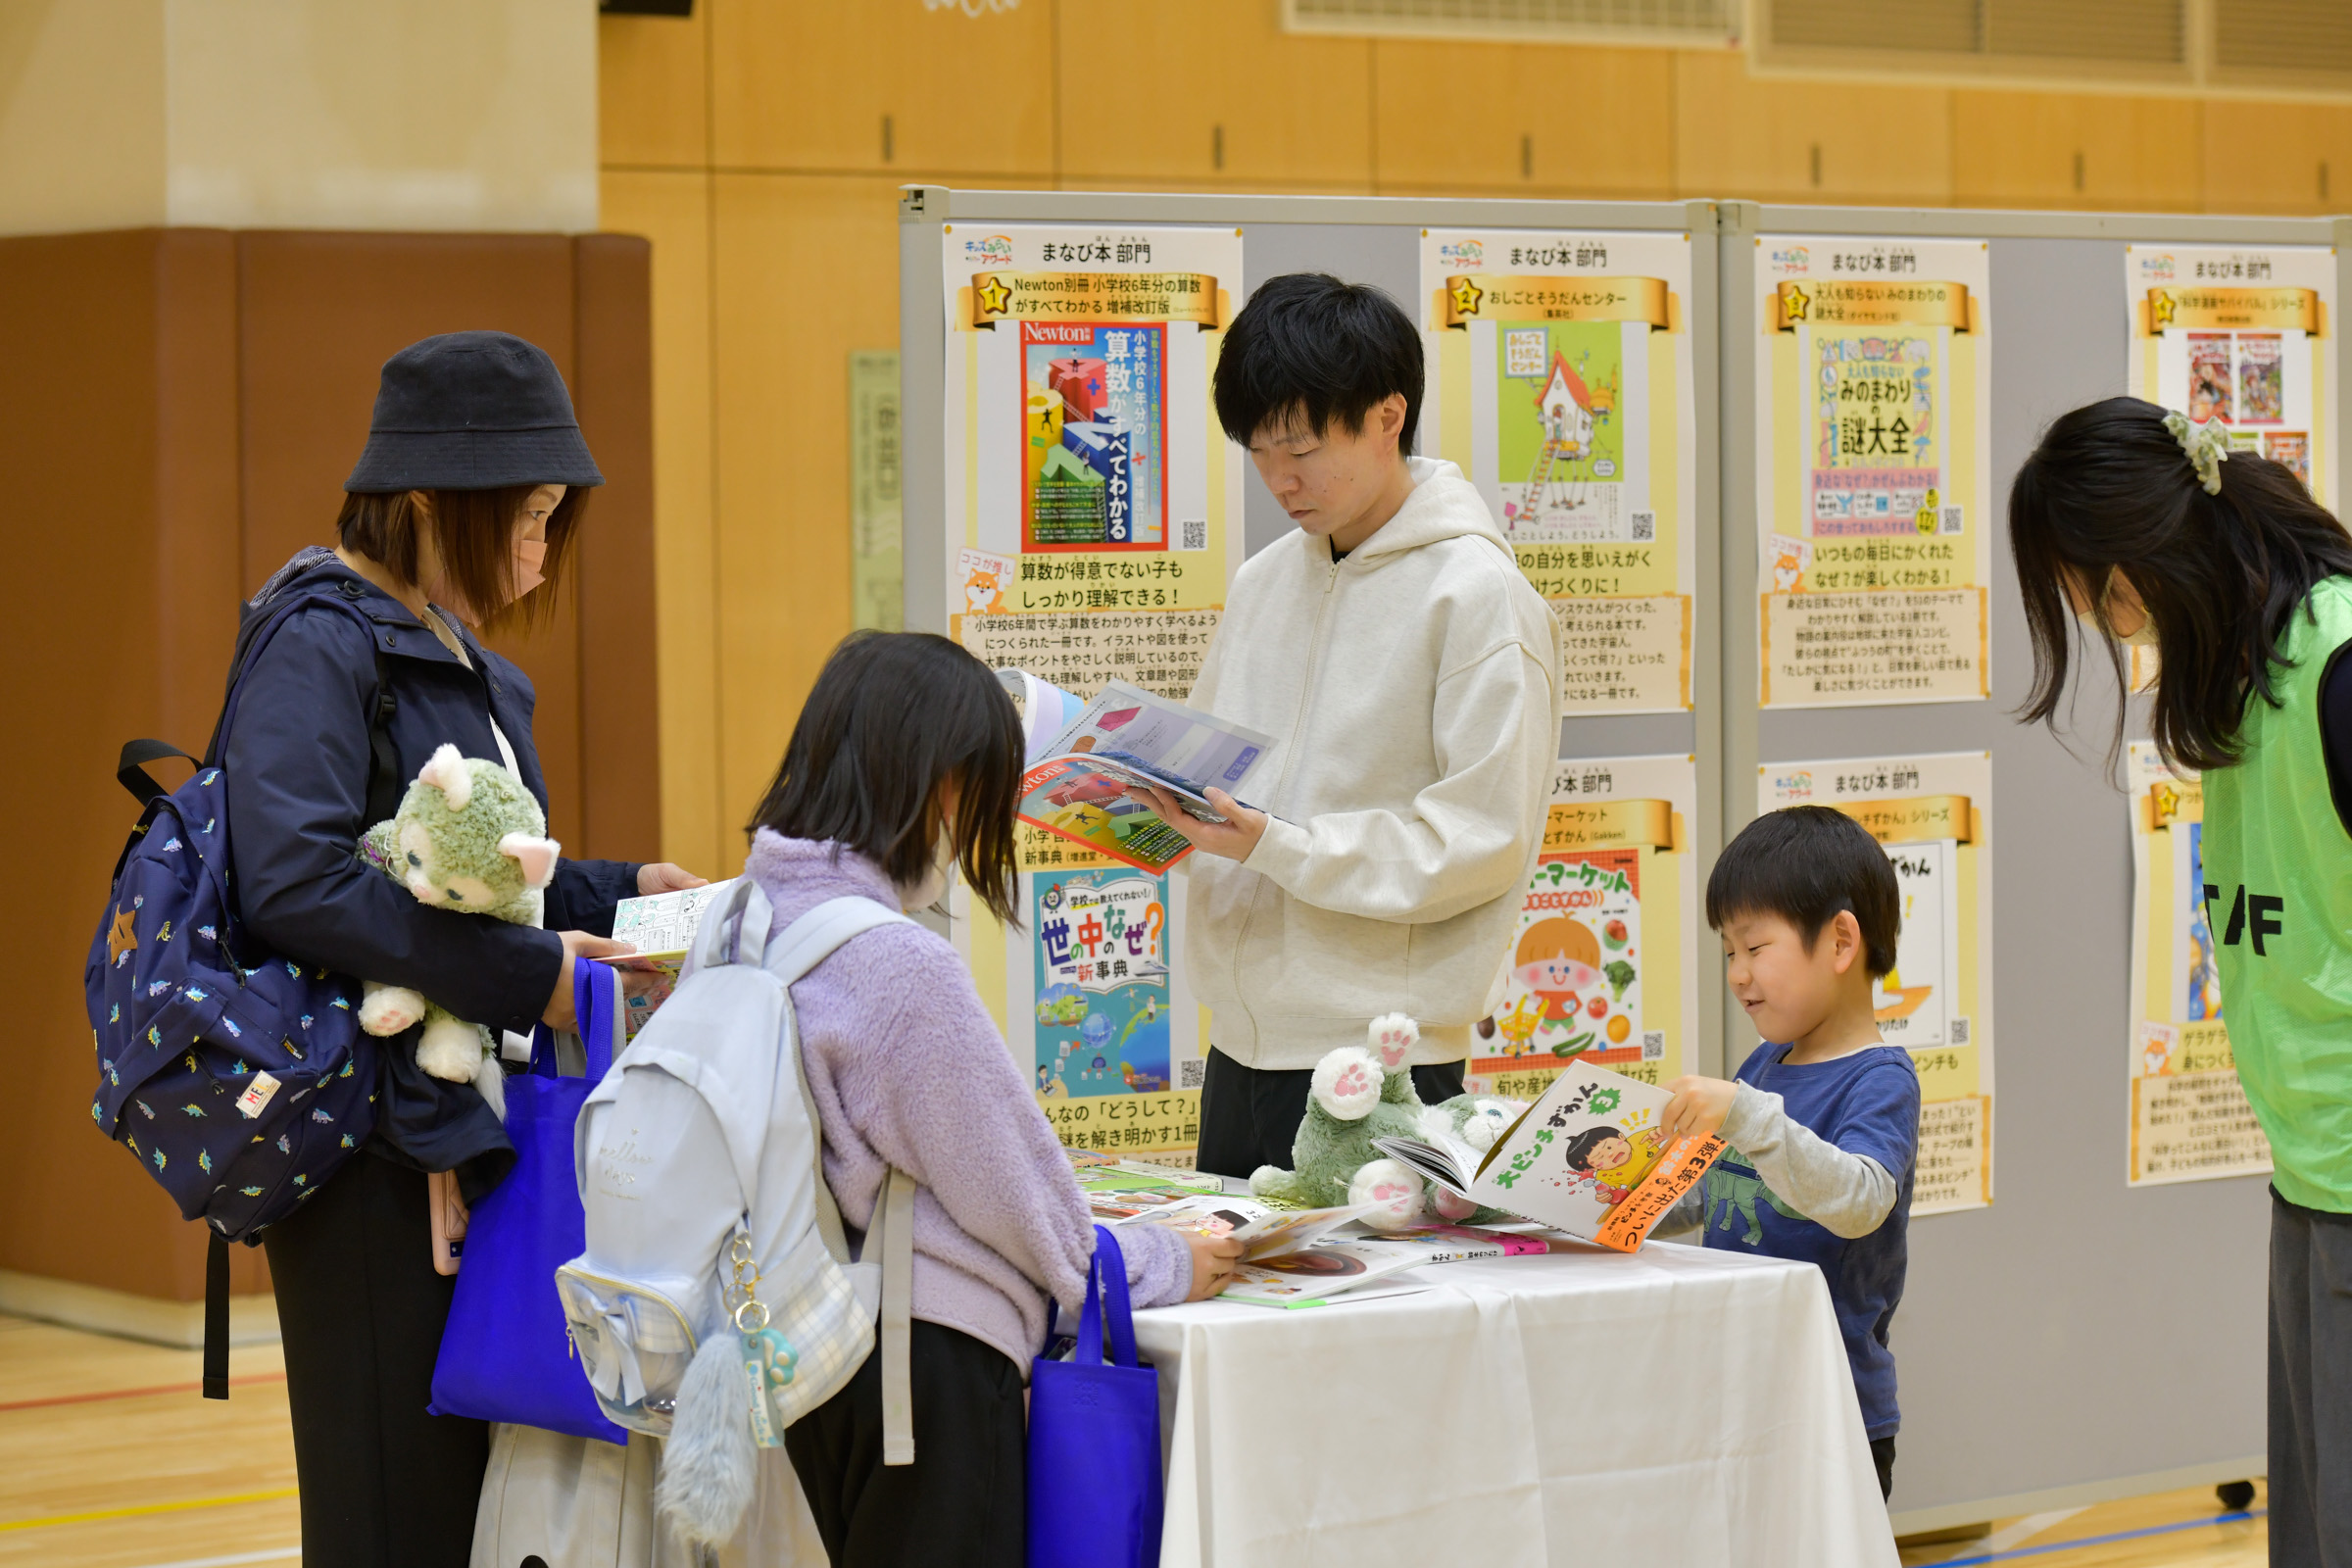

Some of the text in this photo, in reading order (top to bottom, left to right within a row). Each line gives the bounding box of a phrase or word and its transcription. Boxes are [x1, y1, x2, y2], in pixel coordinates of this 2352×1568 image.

[1043, 243, 1152, 264] まなび本 部門
[1510, 248, 1607, 268] まなび本 部門
[1833, 254, 1916, 272] まなび本 部門
[2196, 262, 2271, 279] まなび本 部門
[1015, 278, 1201, 293] Newton別冊 小学校6年分の算数
[990, 288, 996, 304] 1
[1462, 291, 1470, 303] 2
[1490, 290, 1627, 306] おしごとそうだんセンター
[1015, 298, 1171, 315] がすべてわかる 増補改訂版
[1025, 322, 1085, 341] Newton
[1134, 330, 1147, 435] 小学校6年分の
[1841, 380, 1910, 403] みのまわり
[1105, 330, 1131, 539] 算数がすべてわかる
[1842, 416, 1910, 454] 謎大全
[1816, 544, 1953, 562] いつもの毎日にかくれた
[961, 554, 1011, 575] ココが推し
[1021, 561, 1183, 581] 算数が得意でない子も
[1531, 578, 1619, 595] けづくりに！
[1816, 570, 1950, 588] なぜ？が楽しくわかる！
[1023, 589, 1178, 608] しっかり理解できる！
[975, 614, 1217, 632] 小学校6年間で学ぶ算数をわかりやすく学べるよう
[985, 633, 1208, 649] につくられた一冊です。イラストや図を使って
[985, 651, 1203, 668] 大事なポイントをやさしく説明しているので、
[1582, 773, 1612, 793] 部門
[1836, 771, 1919, 793] まなび本 部門
[1025, 851, 1062, 865] 新事典
[1078, 960, 1128, 982] 新事典
[1496, 1083, 1598, 1189] 大ピンチずかん
